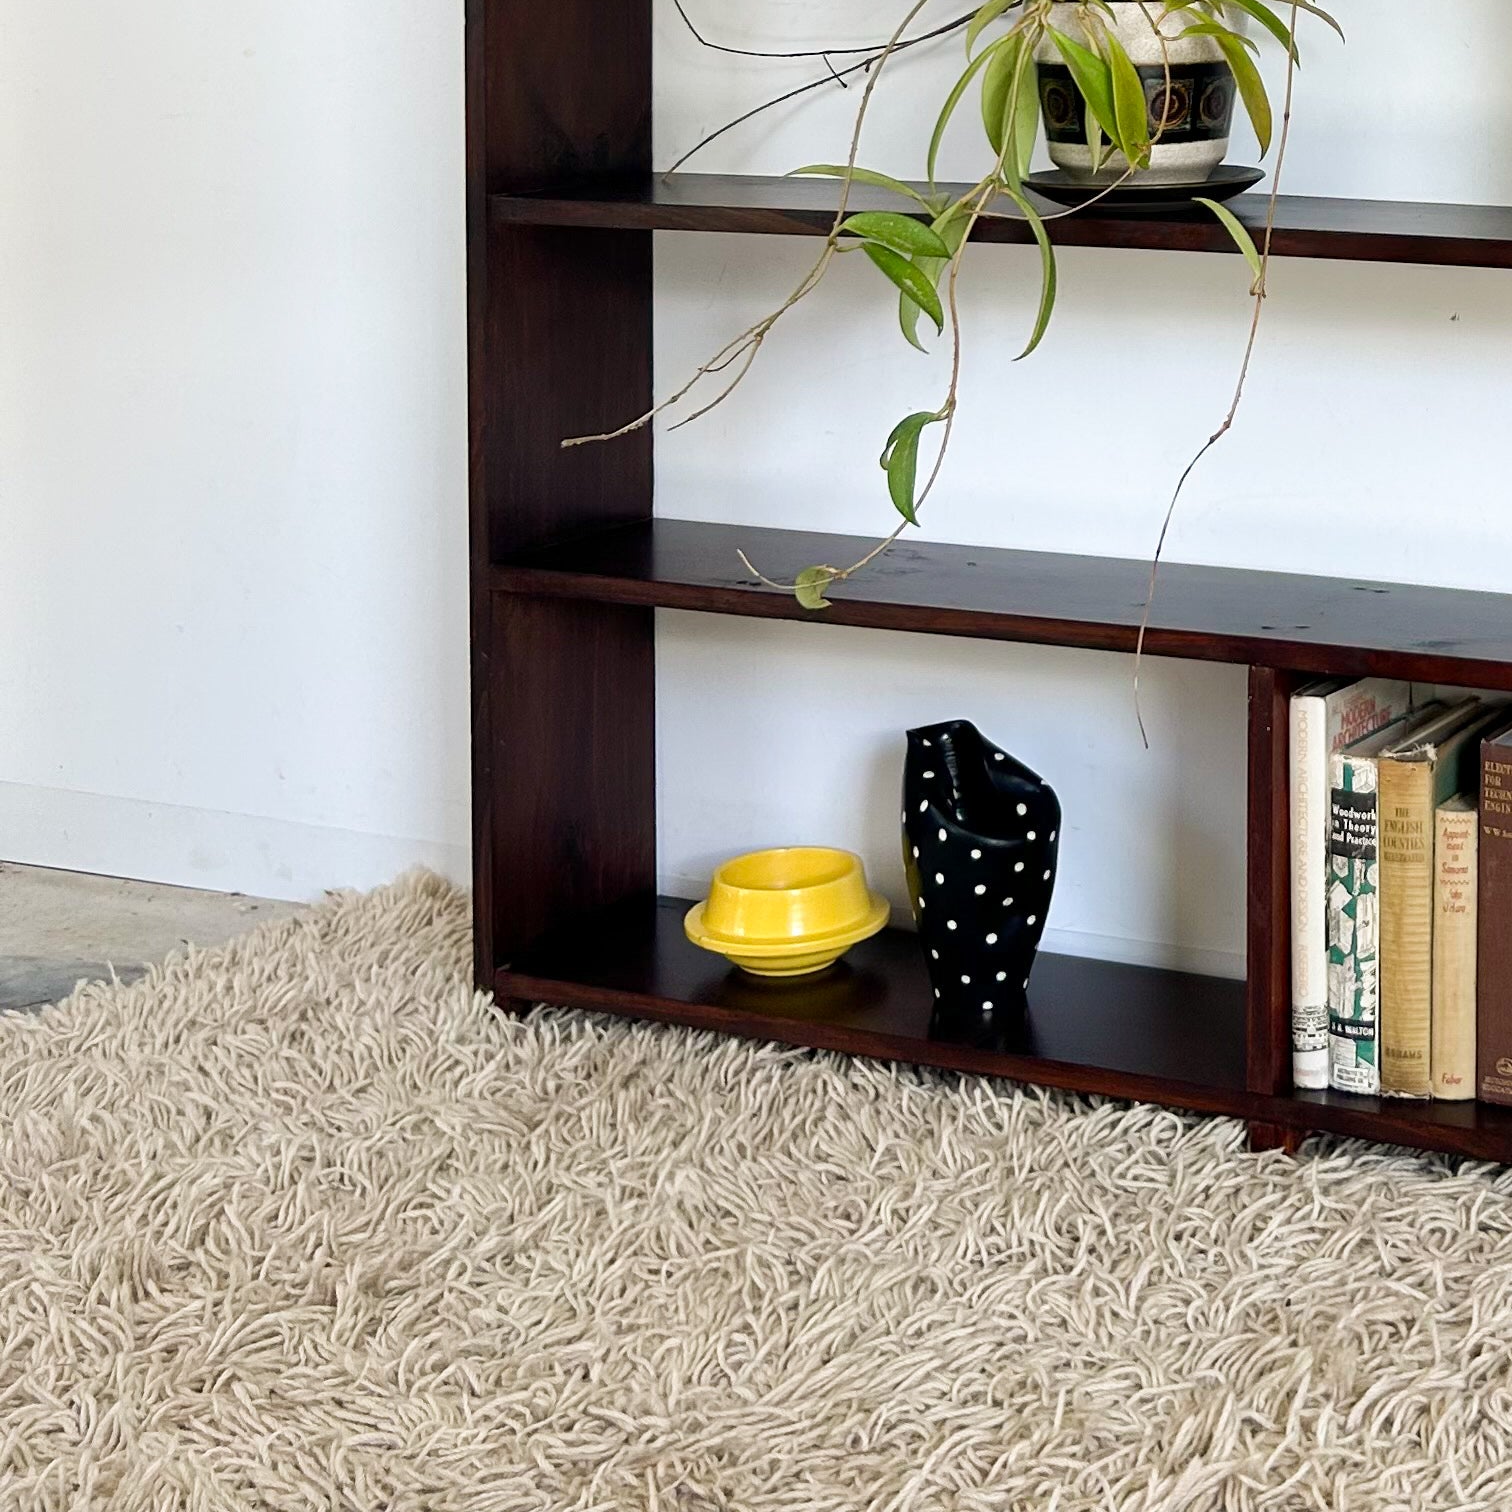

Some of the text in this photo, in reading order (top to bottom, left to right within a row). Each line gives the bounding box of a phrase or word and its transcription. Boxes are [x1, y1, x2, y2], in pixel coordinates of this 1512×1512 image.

[1485, 774, 1502, 786] FOR
[1332, 803, 1376, 820] Woodwork
[1343, 818, 1376, 836] Theory
[1383, 819, 1423, 834] ENGLISH
[1345, 1026, 1374, 1037] WALTON
